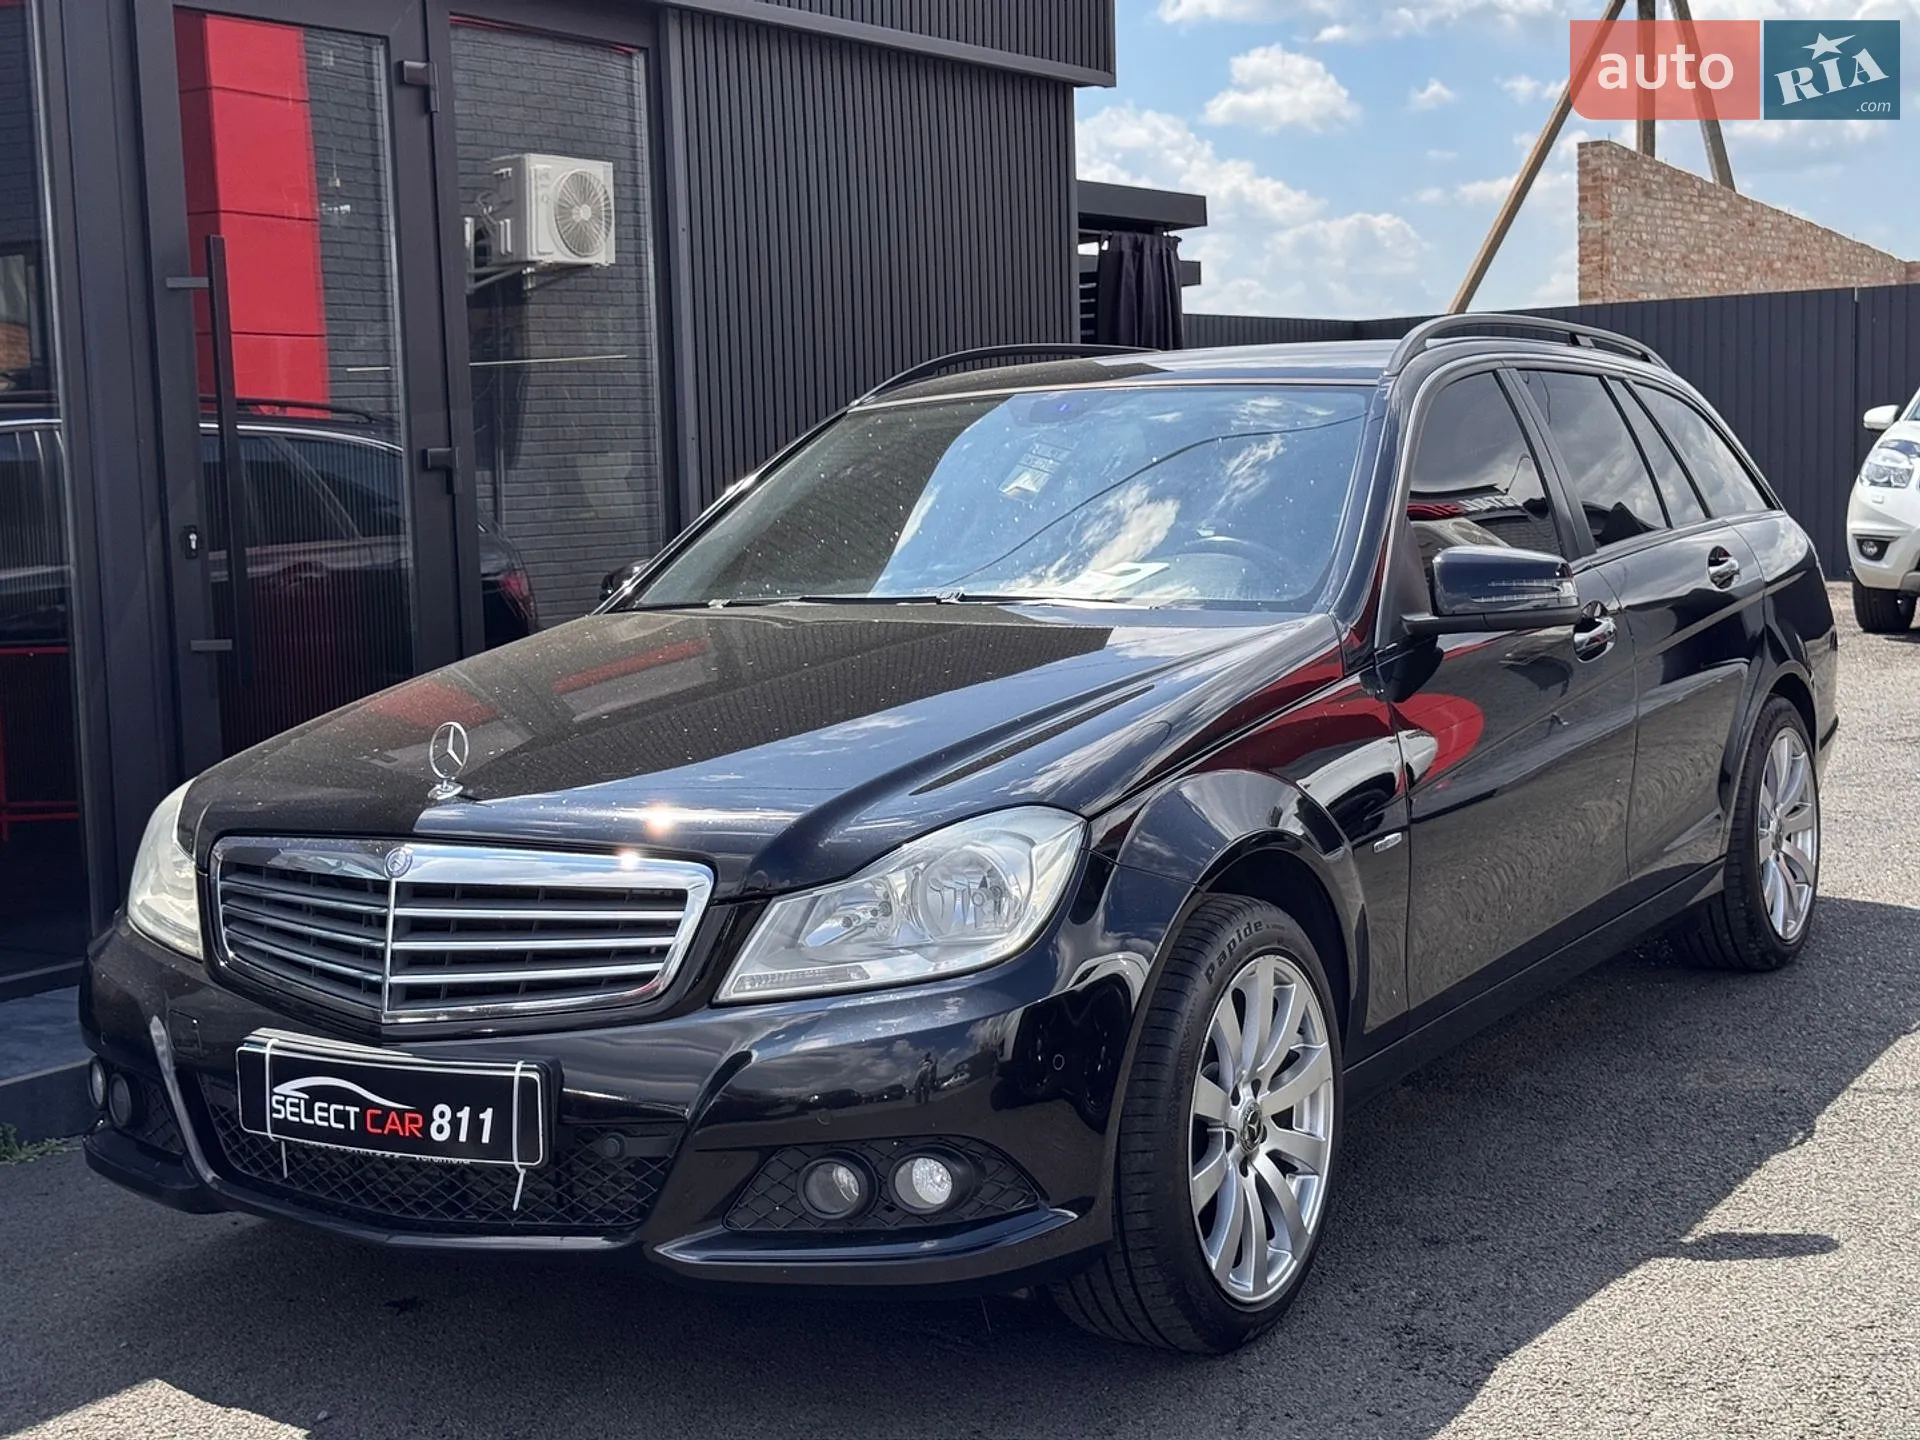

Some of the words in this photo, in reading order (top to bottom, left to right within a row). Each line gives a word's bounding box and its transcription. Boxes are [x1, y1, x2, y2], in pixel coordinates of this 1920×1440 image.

[271, 1095, 360, 1131] SELECT
[364, 1108, 424, 1139] CAR
[430, 1103, 494, 1144] 811
